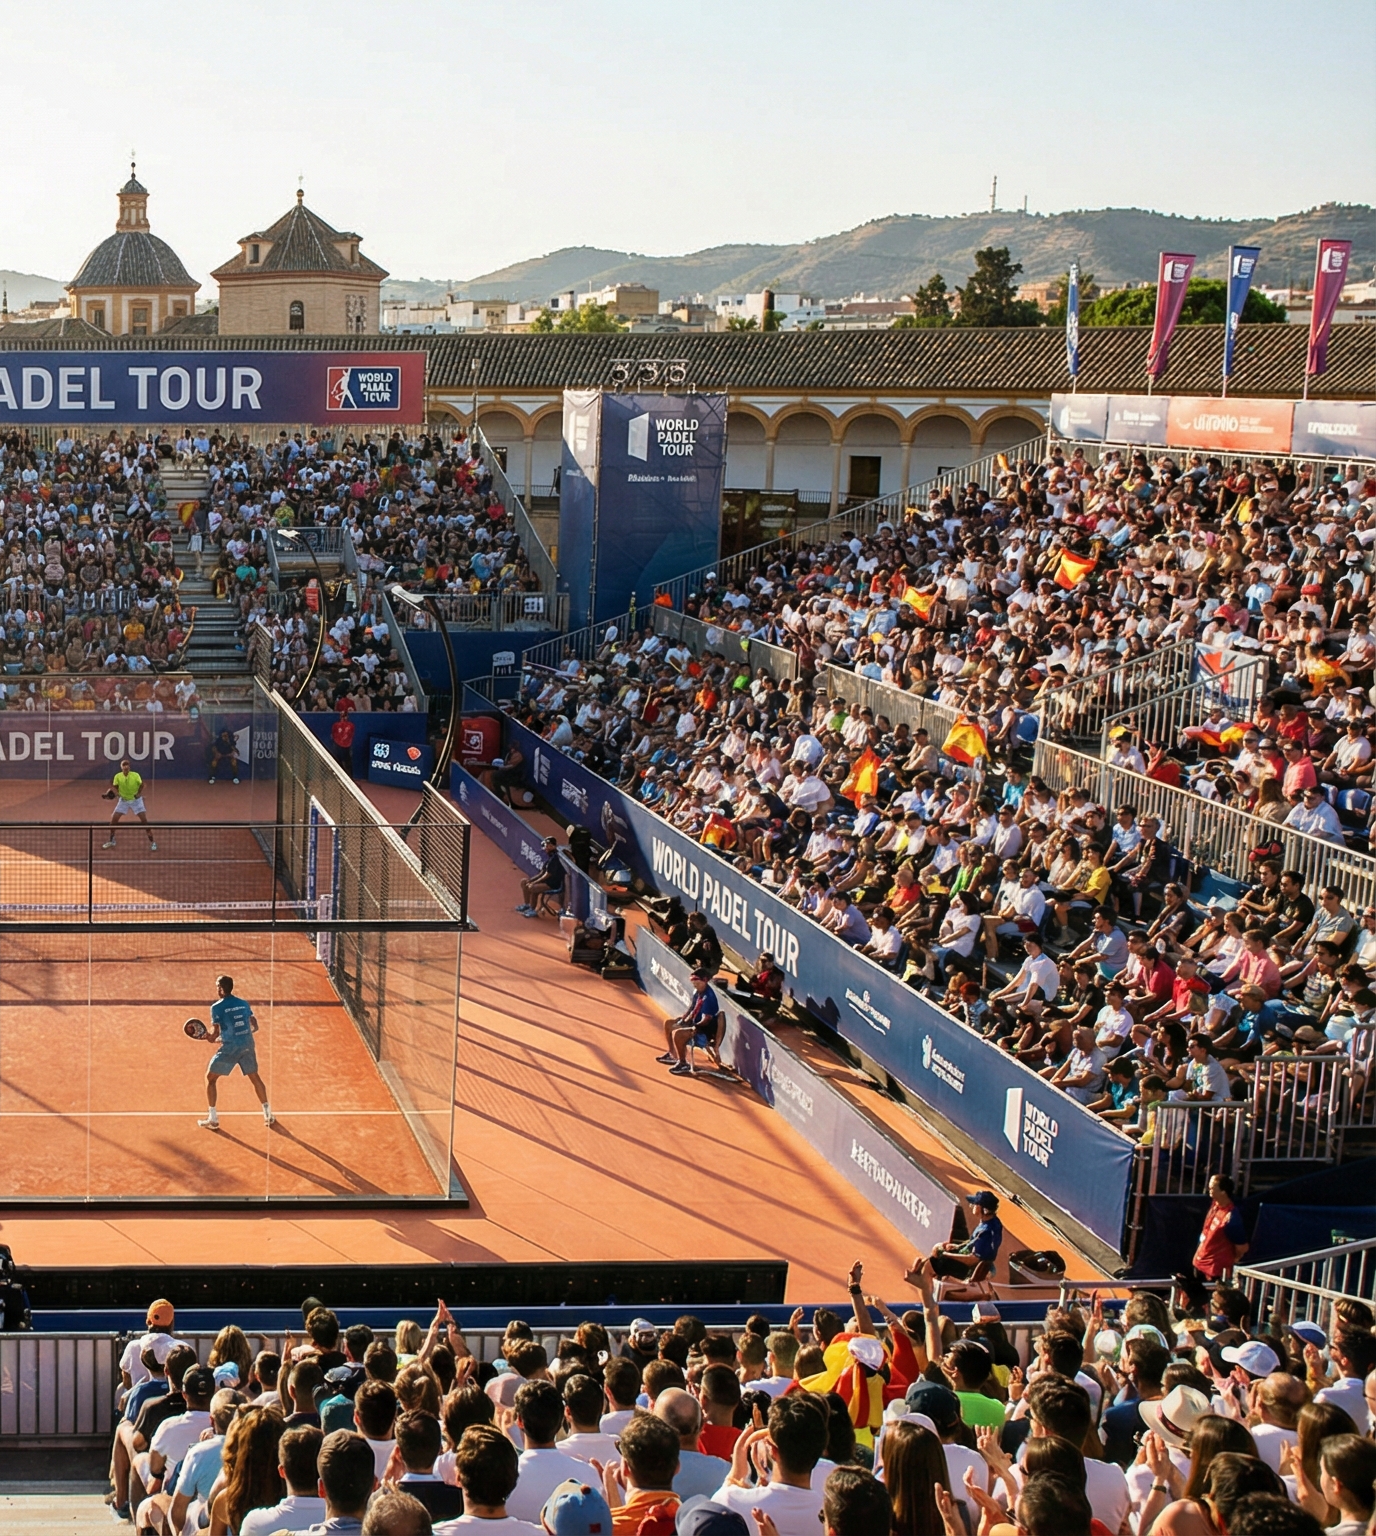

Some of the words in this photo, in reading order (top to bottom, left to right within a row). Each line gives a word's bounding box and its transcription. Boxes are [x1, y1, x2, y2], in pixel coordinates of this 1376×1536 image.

[128, 366, 262, 411] TOUR
[655, 418, 699, 431] WORLD
[657, 431, 697, 443] PADEL
[659, 444, 694, 456] TOUR
[81, 731, 175, 761] TOUR
[652, 836, 700, 900] WORLD
[702, 871, 751, 942] PADEL
[754, 908, 799, 978] TOUR
